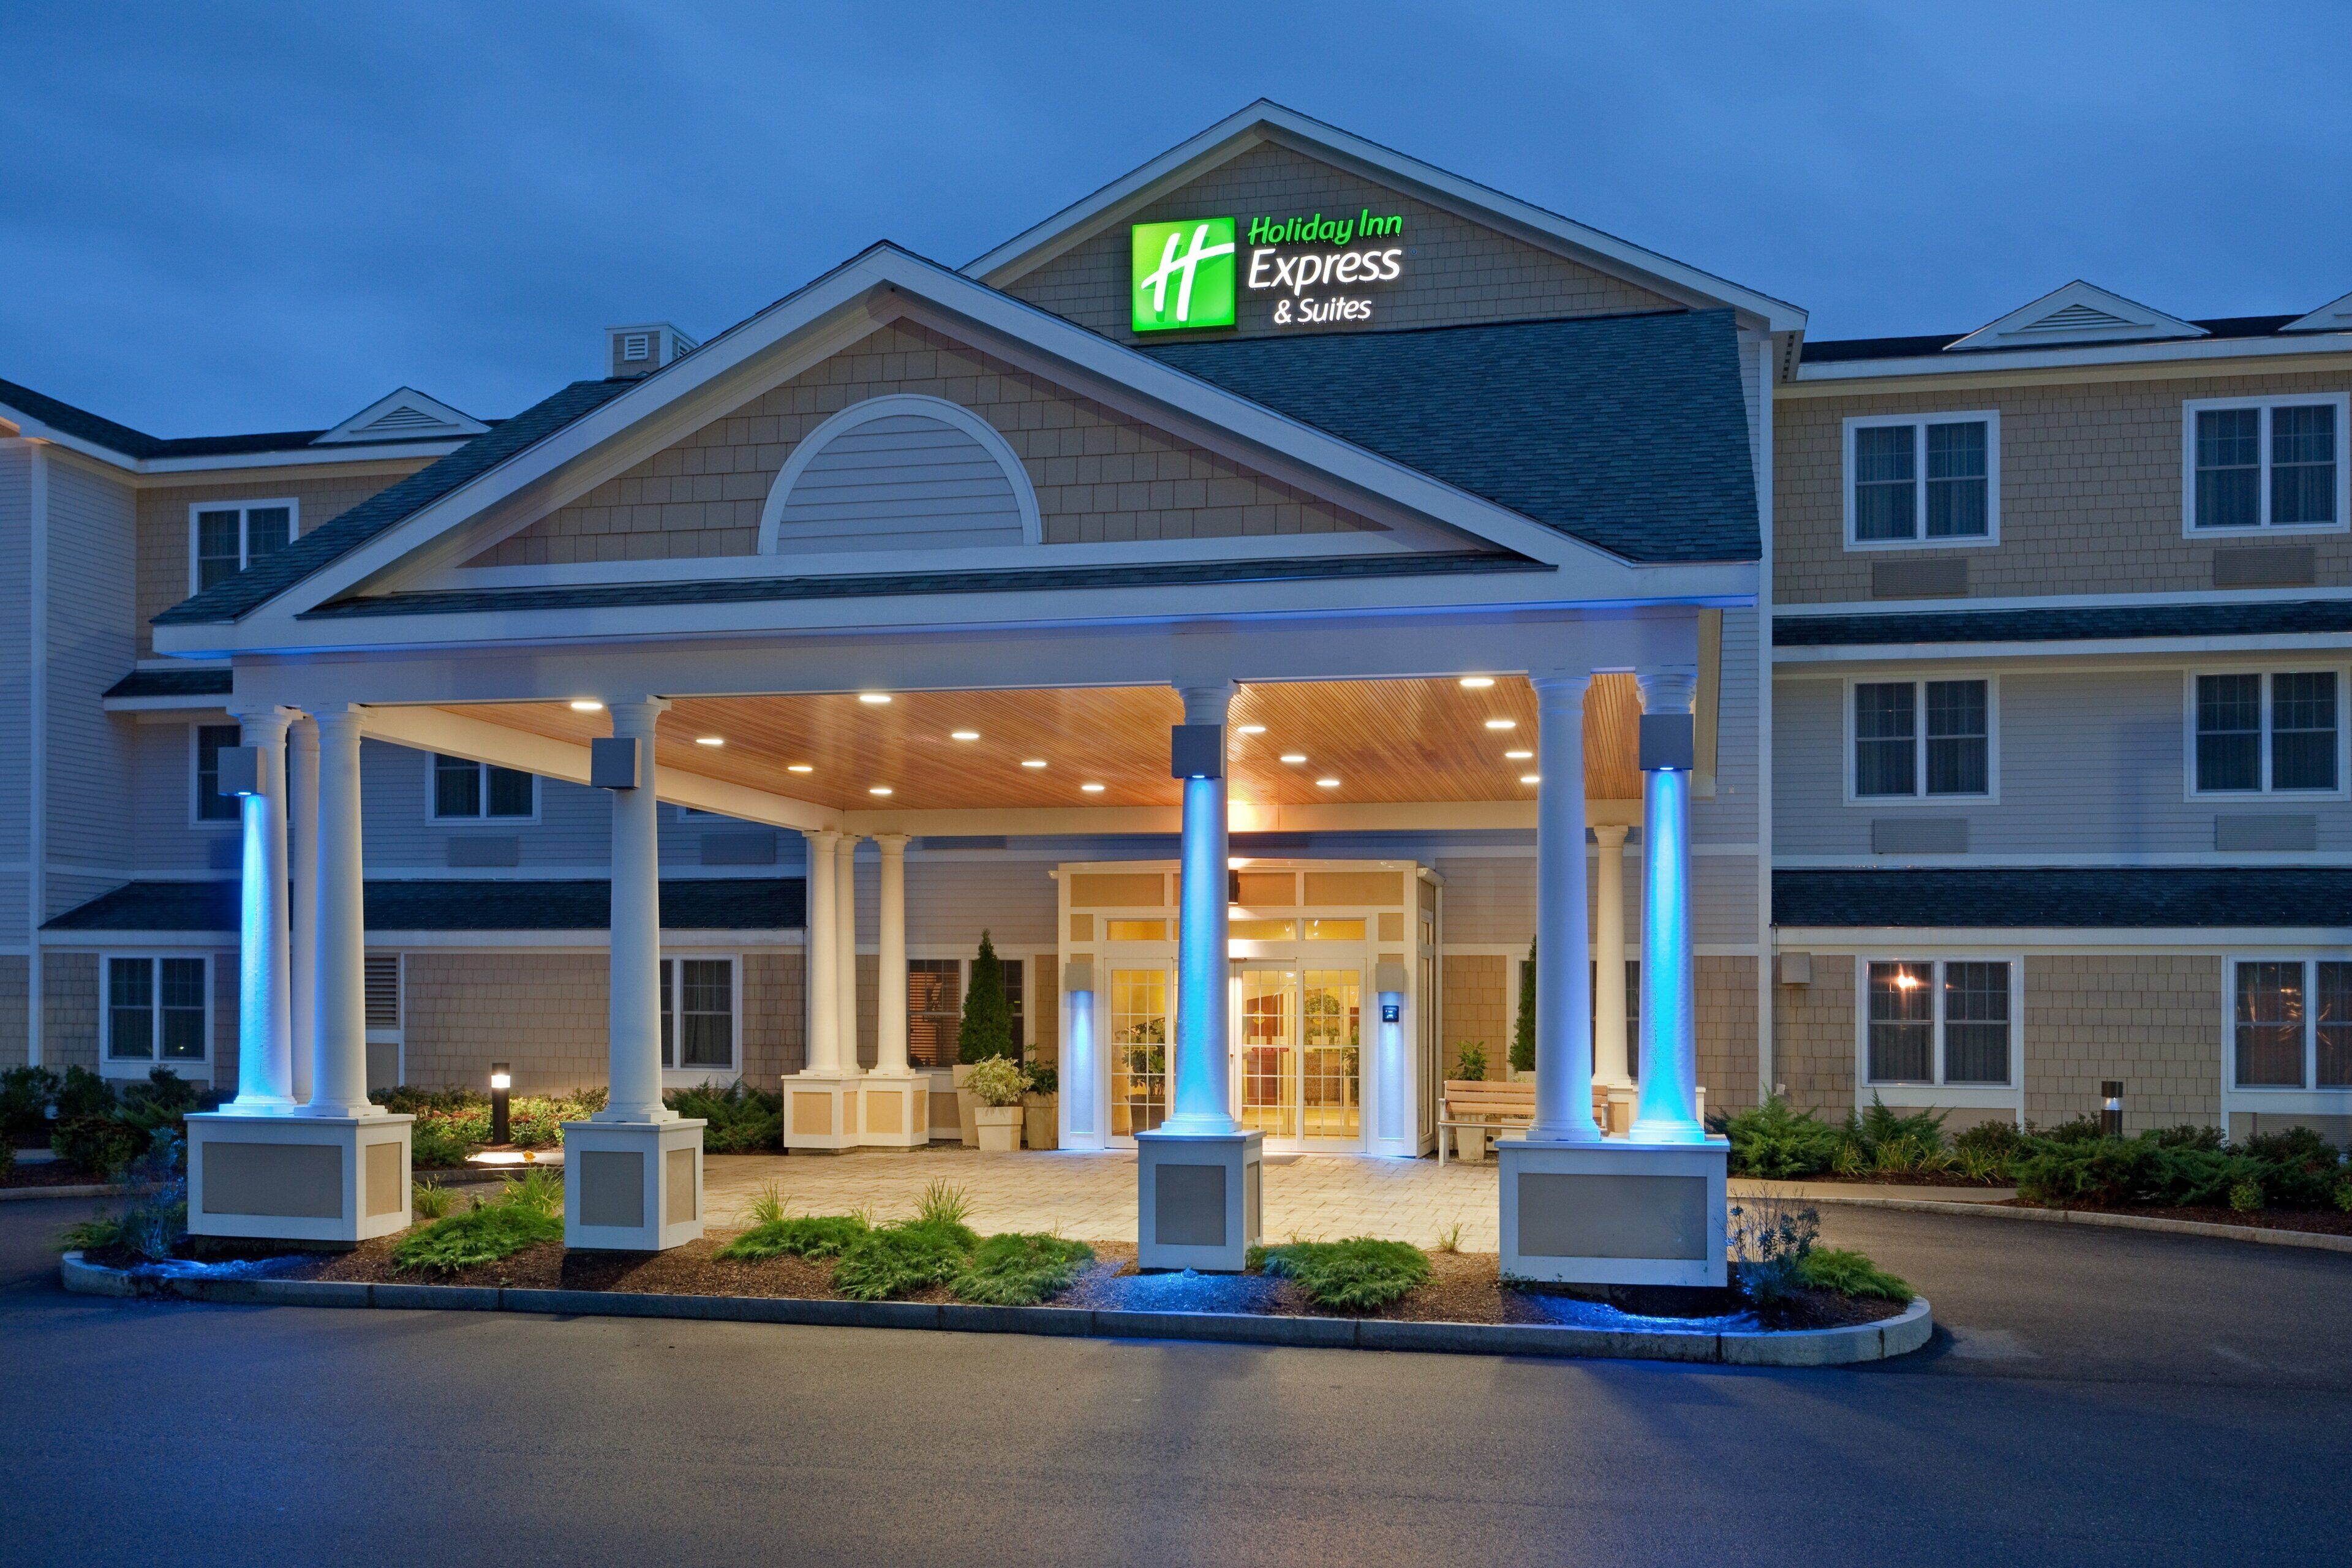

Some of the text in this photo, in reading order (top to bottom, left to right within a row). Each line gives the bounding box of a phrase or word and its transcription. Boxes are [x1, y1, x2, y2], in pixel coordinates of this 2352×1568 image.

[1248, 209, 1403, 245] Holiday Inn
[1141, 224, 1234, 322] H
[1248, 247, 1402, 296] Express
[1273, 298, 1372, 325] & Suites
